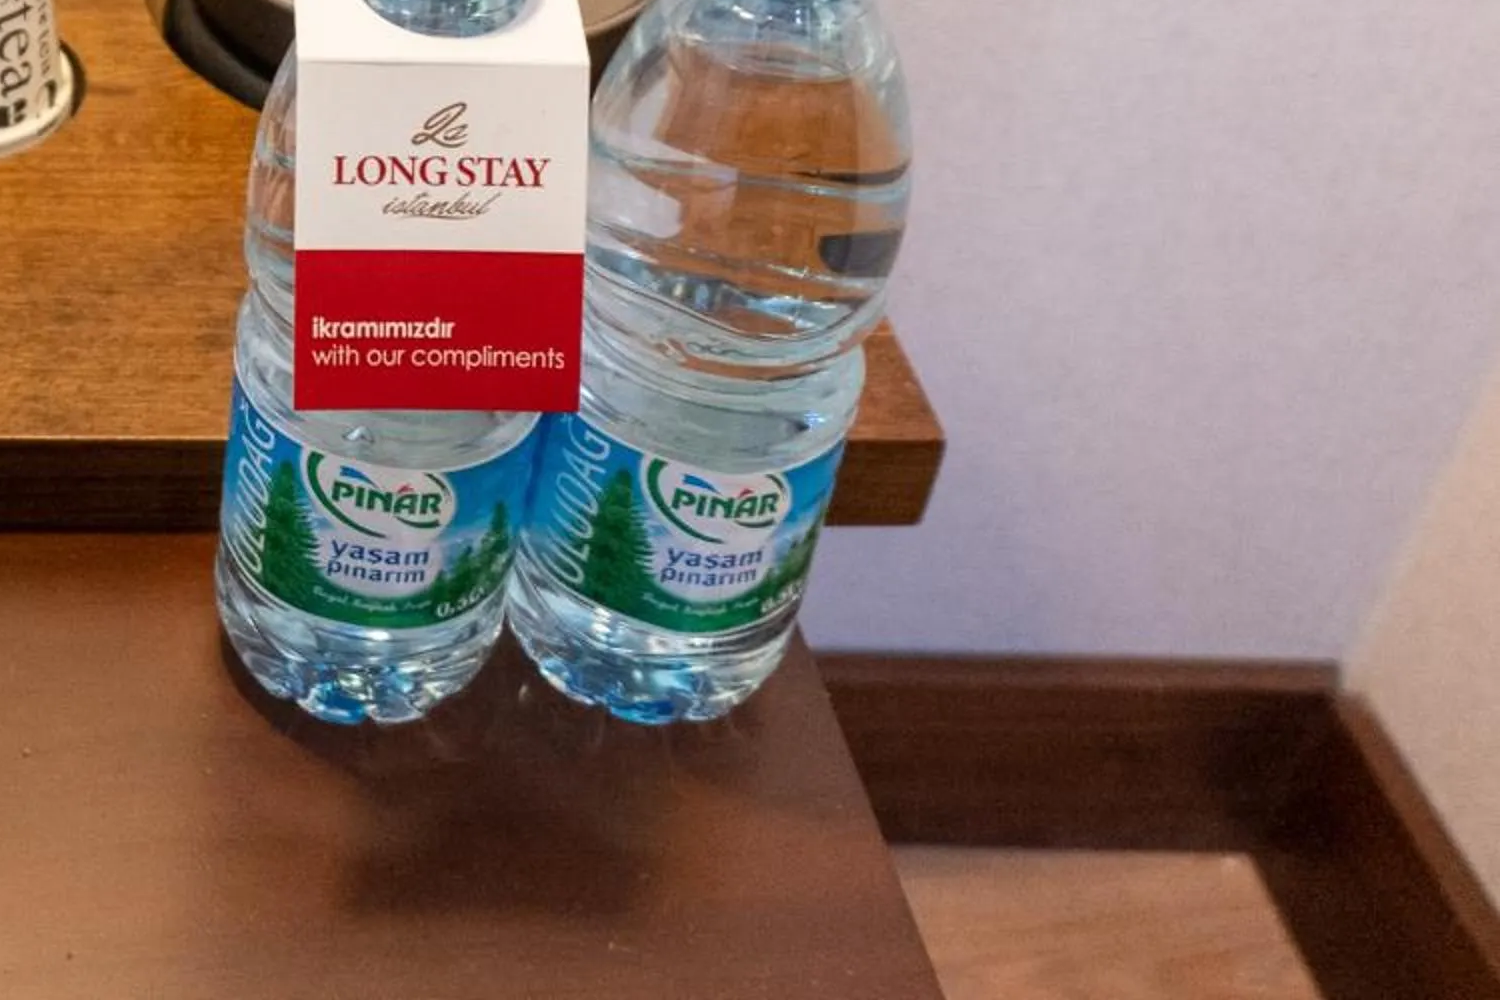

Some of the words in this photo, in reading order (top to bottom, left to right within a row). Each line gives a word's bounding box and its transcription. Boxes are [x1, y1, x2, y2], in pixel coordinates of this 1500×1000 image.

[333, 154, 448, 186] LONG
[456, 156, 551, 188] STAY
[312, 344, 360, 367] with
[366, 348, 405, 367] our
[411, 345, 566, 372] compliments
